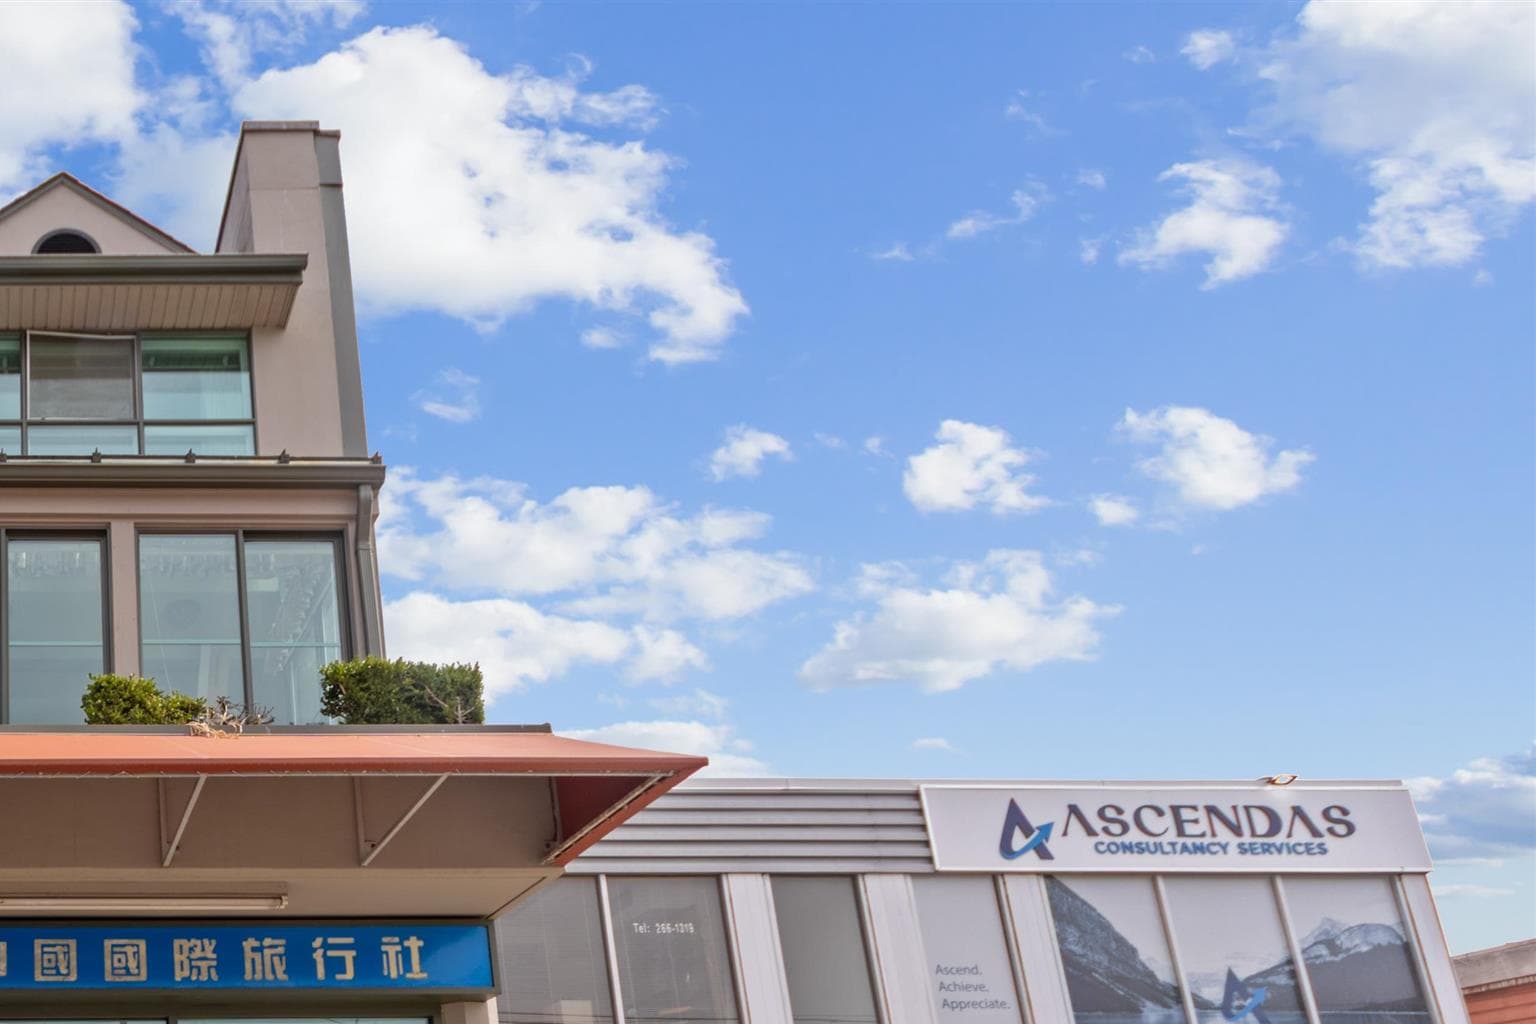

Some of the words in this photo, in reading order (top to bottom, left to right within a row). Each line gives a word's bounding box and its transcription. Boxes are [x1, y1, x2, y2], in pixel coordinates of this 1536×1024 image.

[1062, 803, 1356, 839] ASCENDAS
[1093, 840, 1228, 856] CONSULTANCY
[1238, 840, 1327, 856] SERVICES
[935, 963, 983, 977] Ascend.
[939, 981, 989, 994] Achieve.
[942, 998, 1011, 1013] Appreciate.
